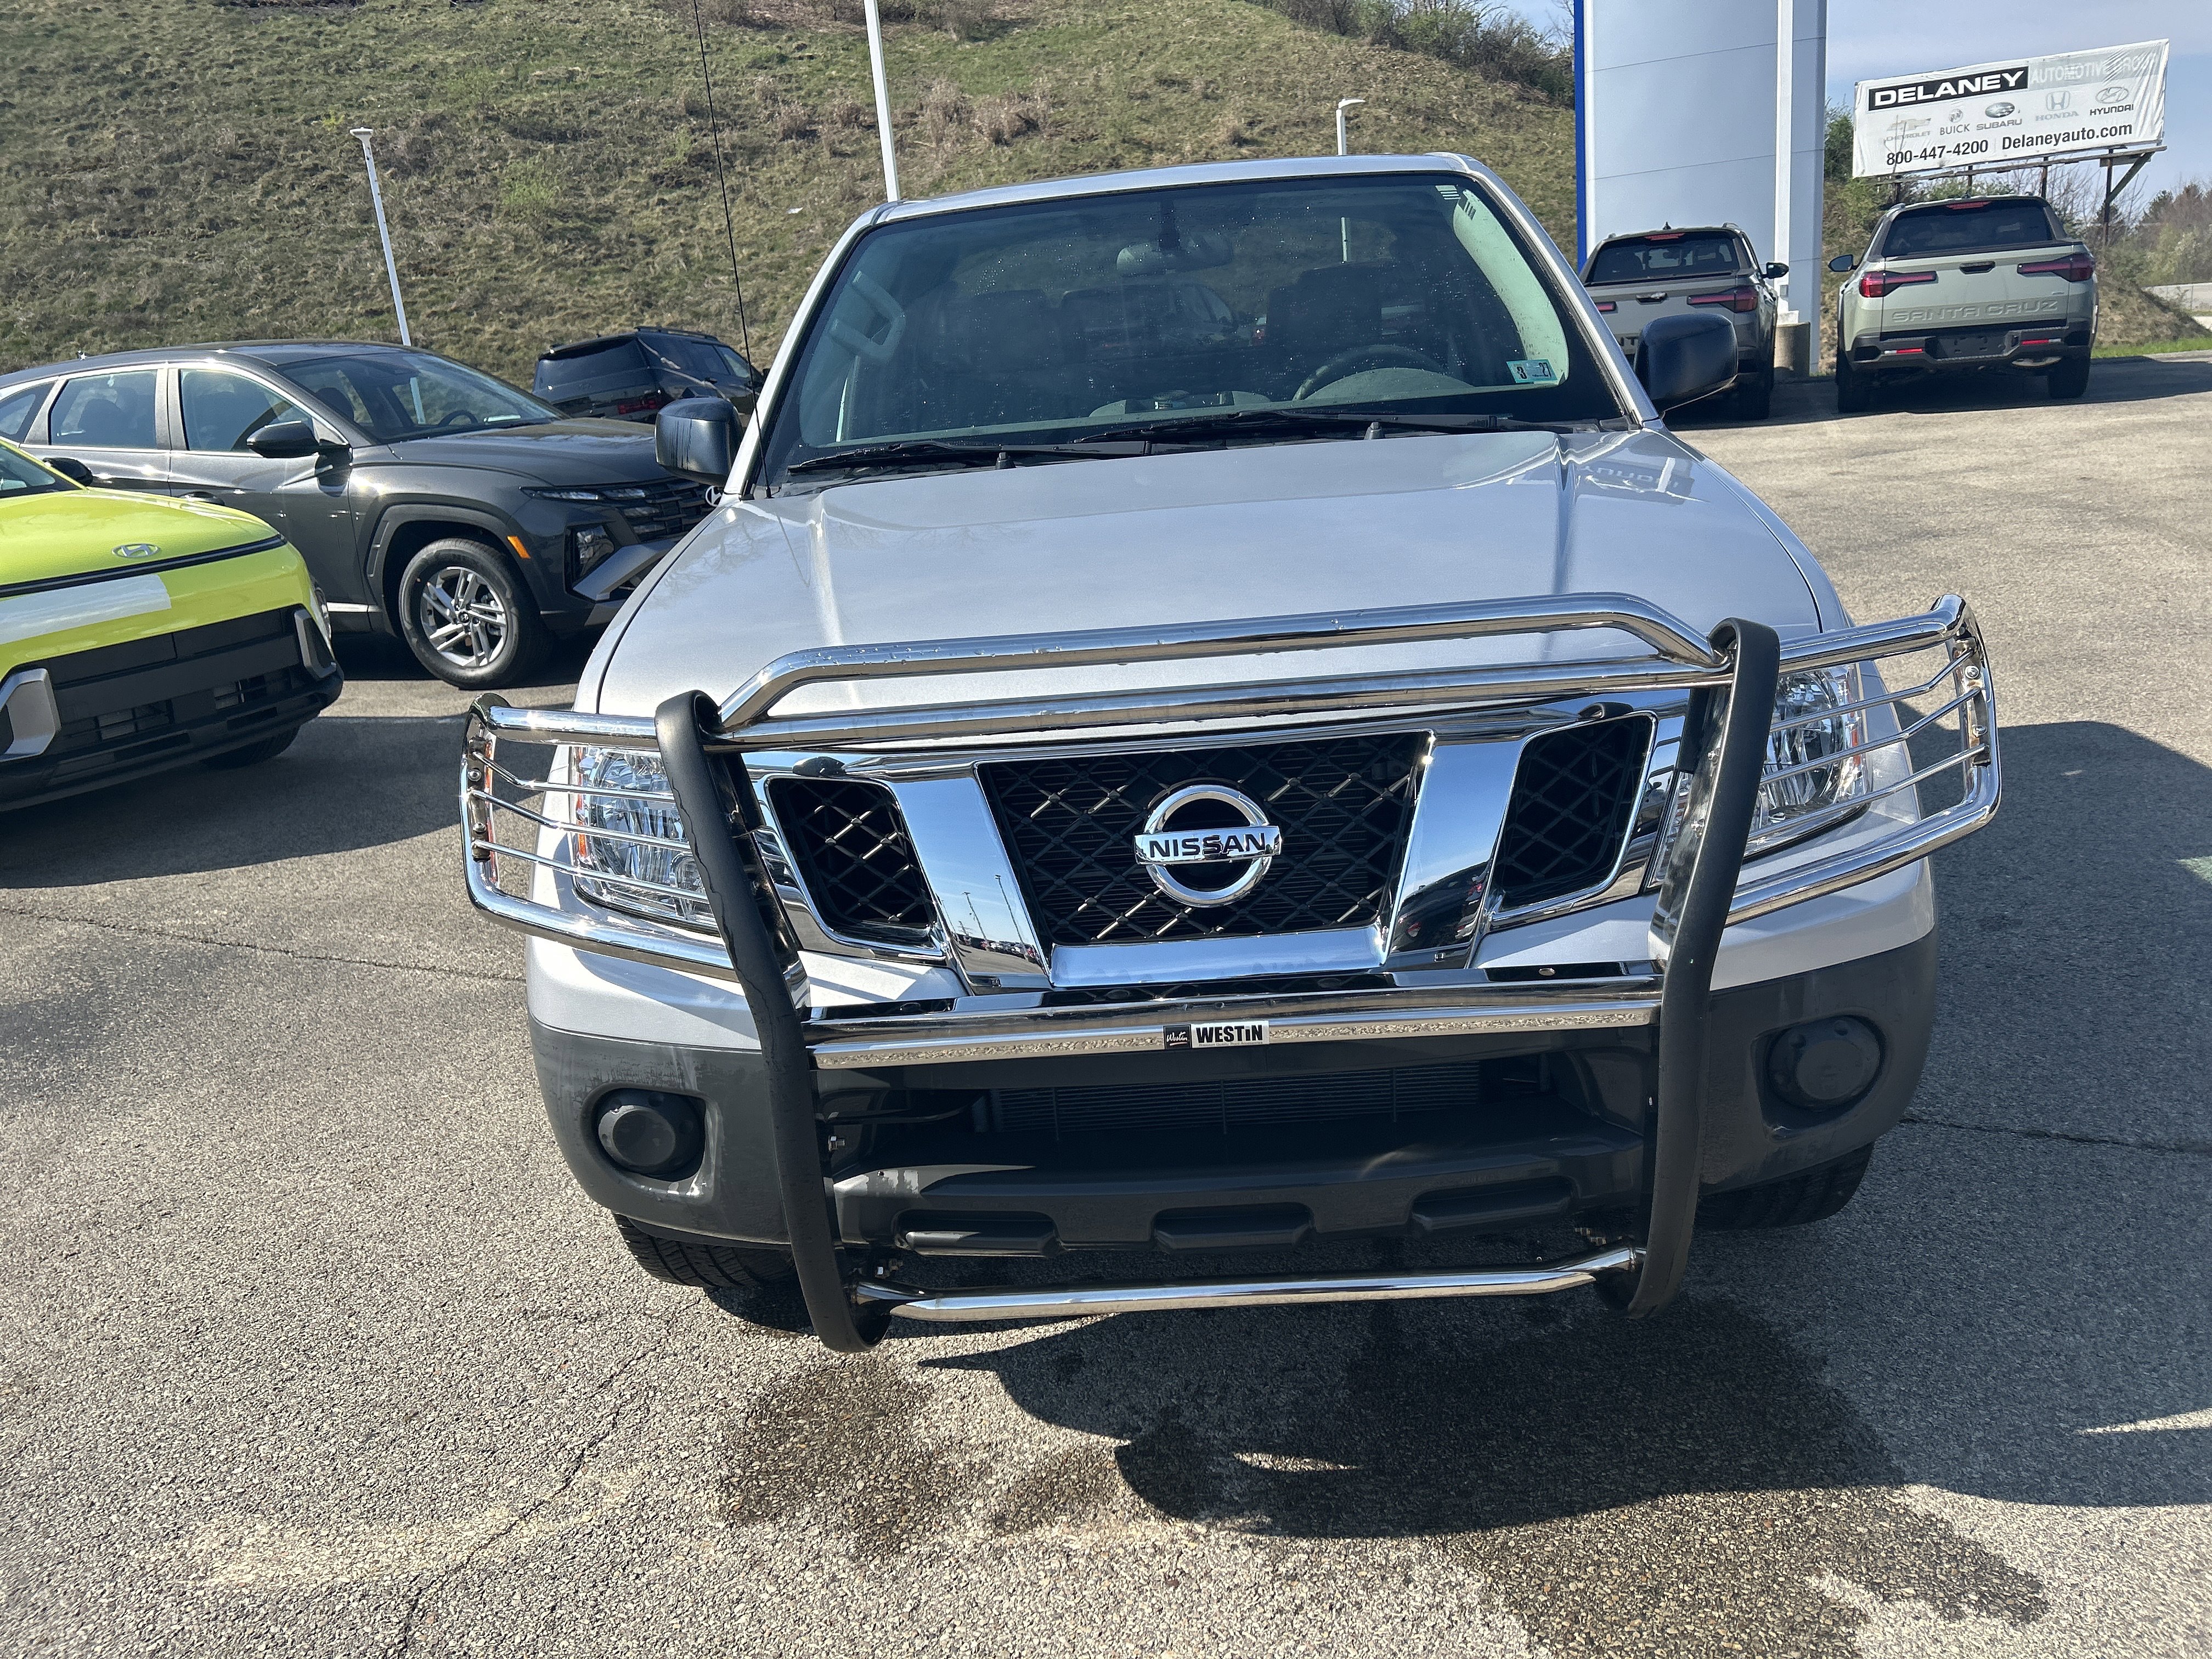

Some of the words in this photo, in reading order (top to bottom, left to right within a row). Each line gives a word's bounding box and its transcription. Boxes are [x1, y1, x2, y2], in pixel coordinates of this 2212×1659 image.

[1875, 70, 2024, 106] DELANEY
[2035, 111, 2079, 121] HONDA
[2089, 104, 2134, 116] HYUNDAI
[1939, 123, 1970, 136] BUICK
[1976, 118, 2022, 131] SUBARU
[1886, 139, 1989, 166] 800-447-4200
[2002, 123, 2132, 150] Delaneyauto.com
[1892, 307, 1980, 324] SANTA
[1986, 301, 2058, 317] CRUZ
[1516, 366, 1527, 379] 3
[1149, 832, 1266, 858] NISSAN
